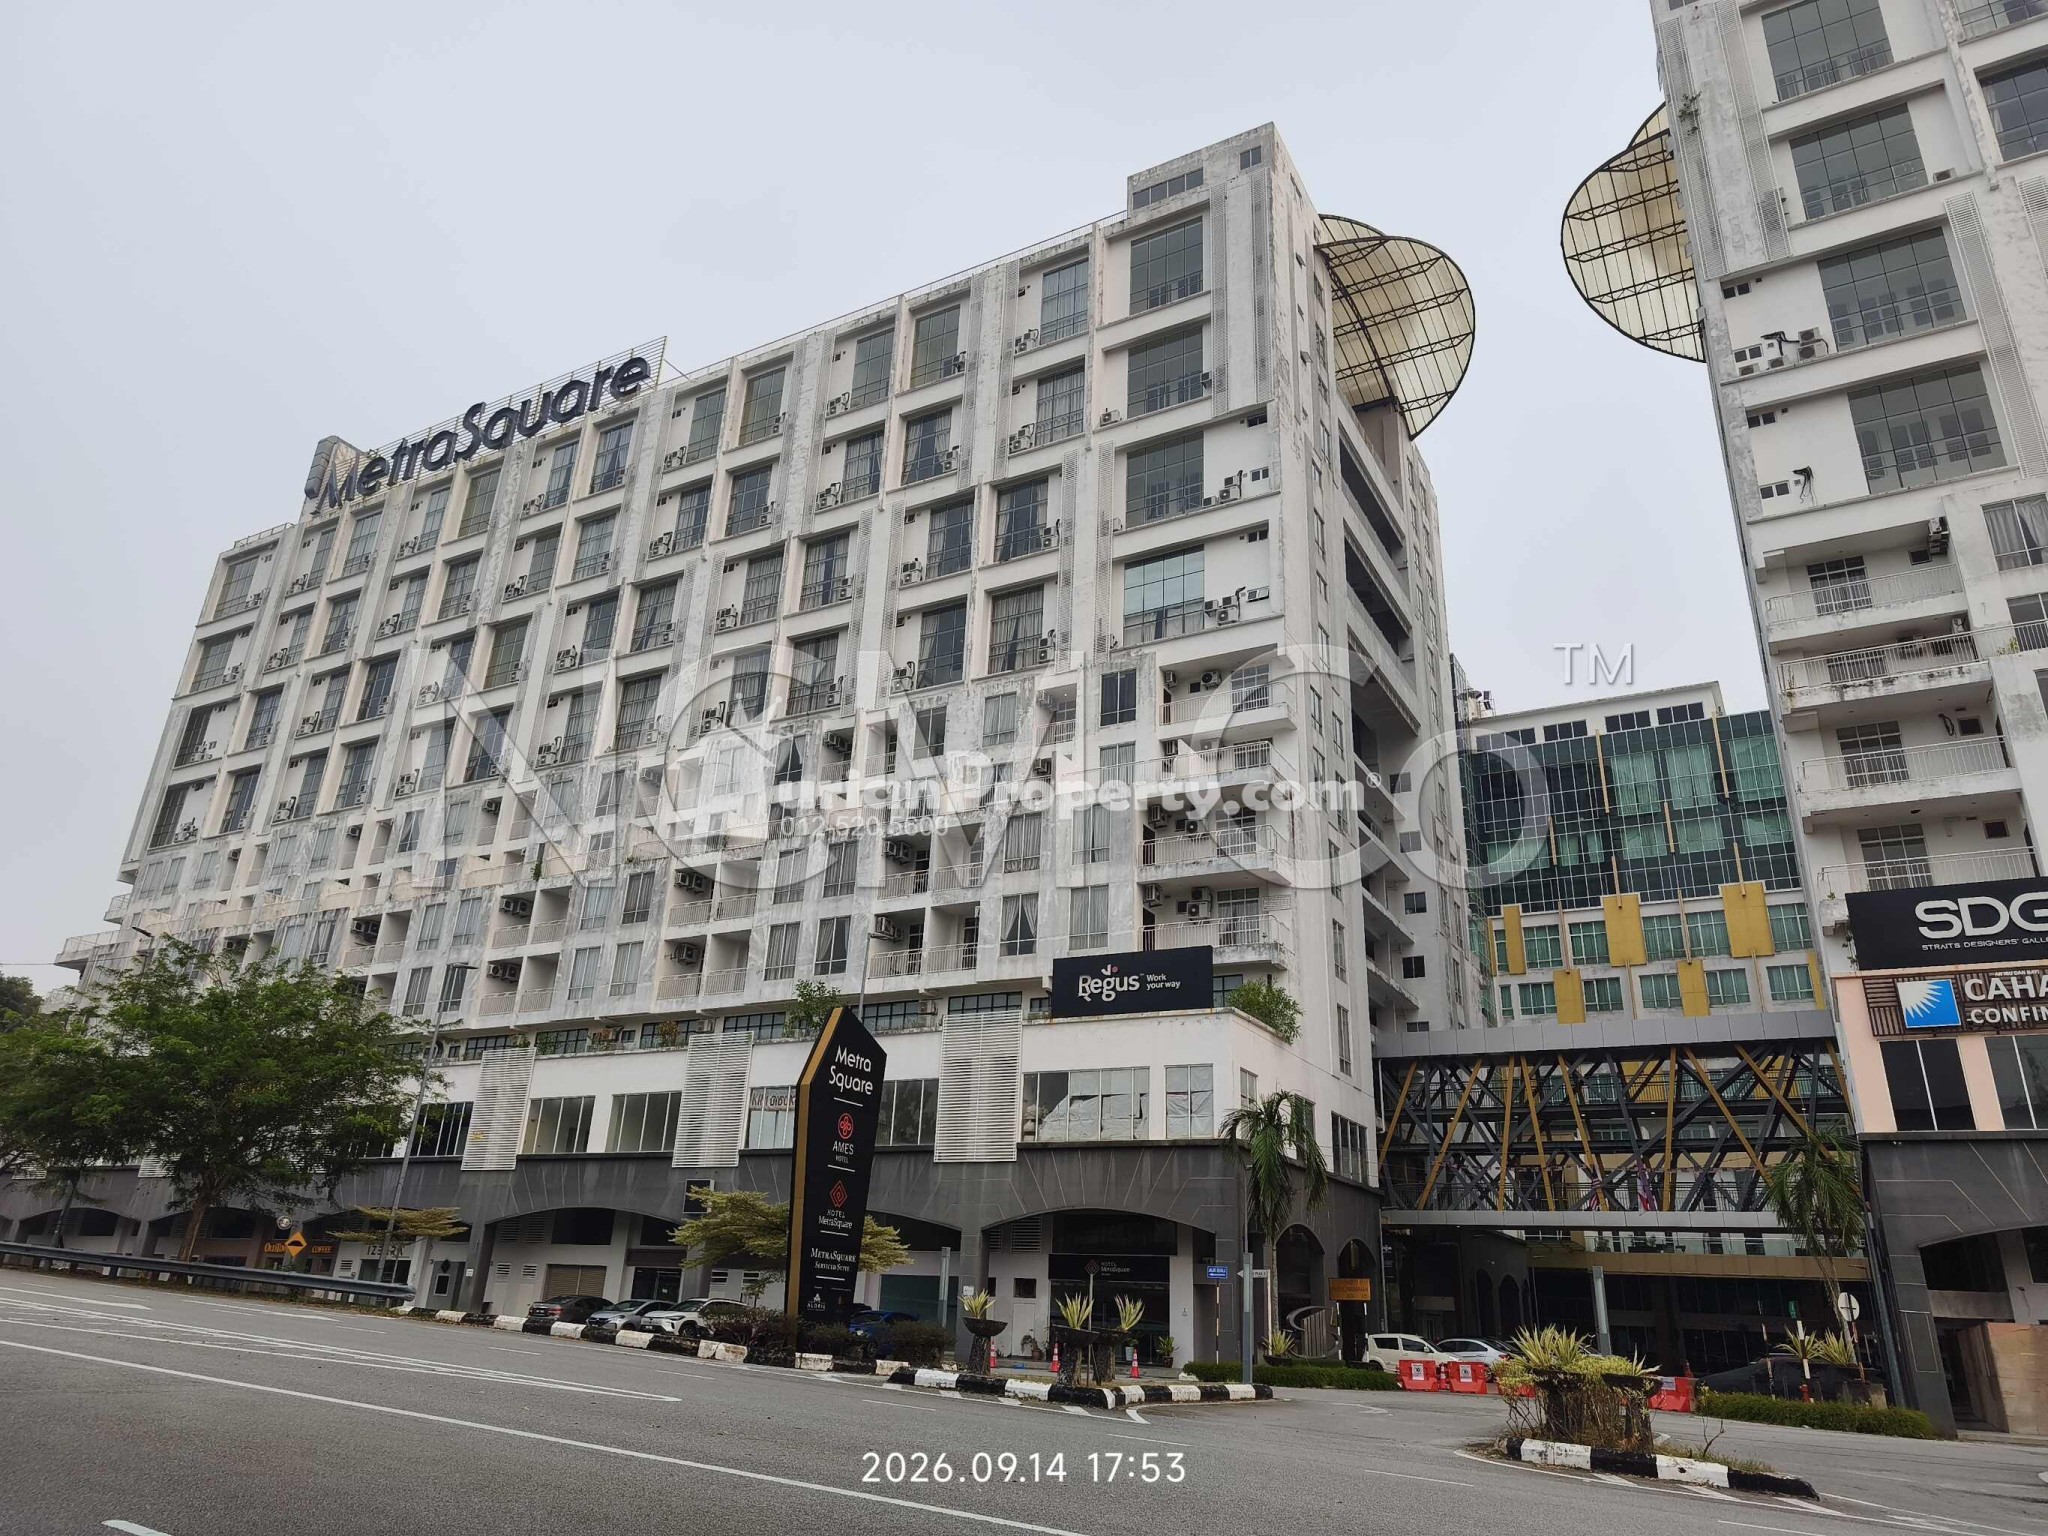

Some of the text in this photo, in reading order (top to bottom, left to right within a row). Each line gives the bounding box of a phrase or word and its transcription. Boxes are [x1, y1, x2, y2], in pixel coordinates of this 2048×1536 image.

[310, 356, 651, 515] MetraSquare
[1915, 890, 2048, 939] SDG
[1921, 942, 1961, 951] STRAITS
[1146, 973, 1167, 982] Work
[1077, 973, 1140, 1002] Regus
[1146, 980, 1181, 991] your way
[834, 1044, 872, 1072] Metra
[828, 1065, 874, 1095] Square
[832, 1140, 854, 1155] AMES
[835, 1155, 849, 1164] HOTEL
[826, 1208, 846, 1219] HOTEL
[818, 1215, 853, 1230] MetraSquare
